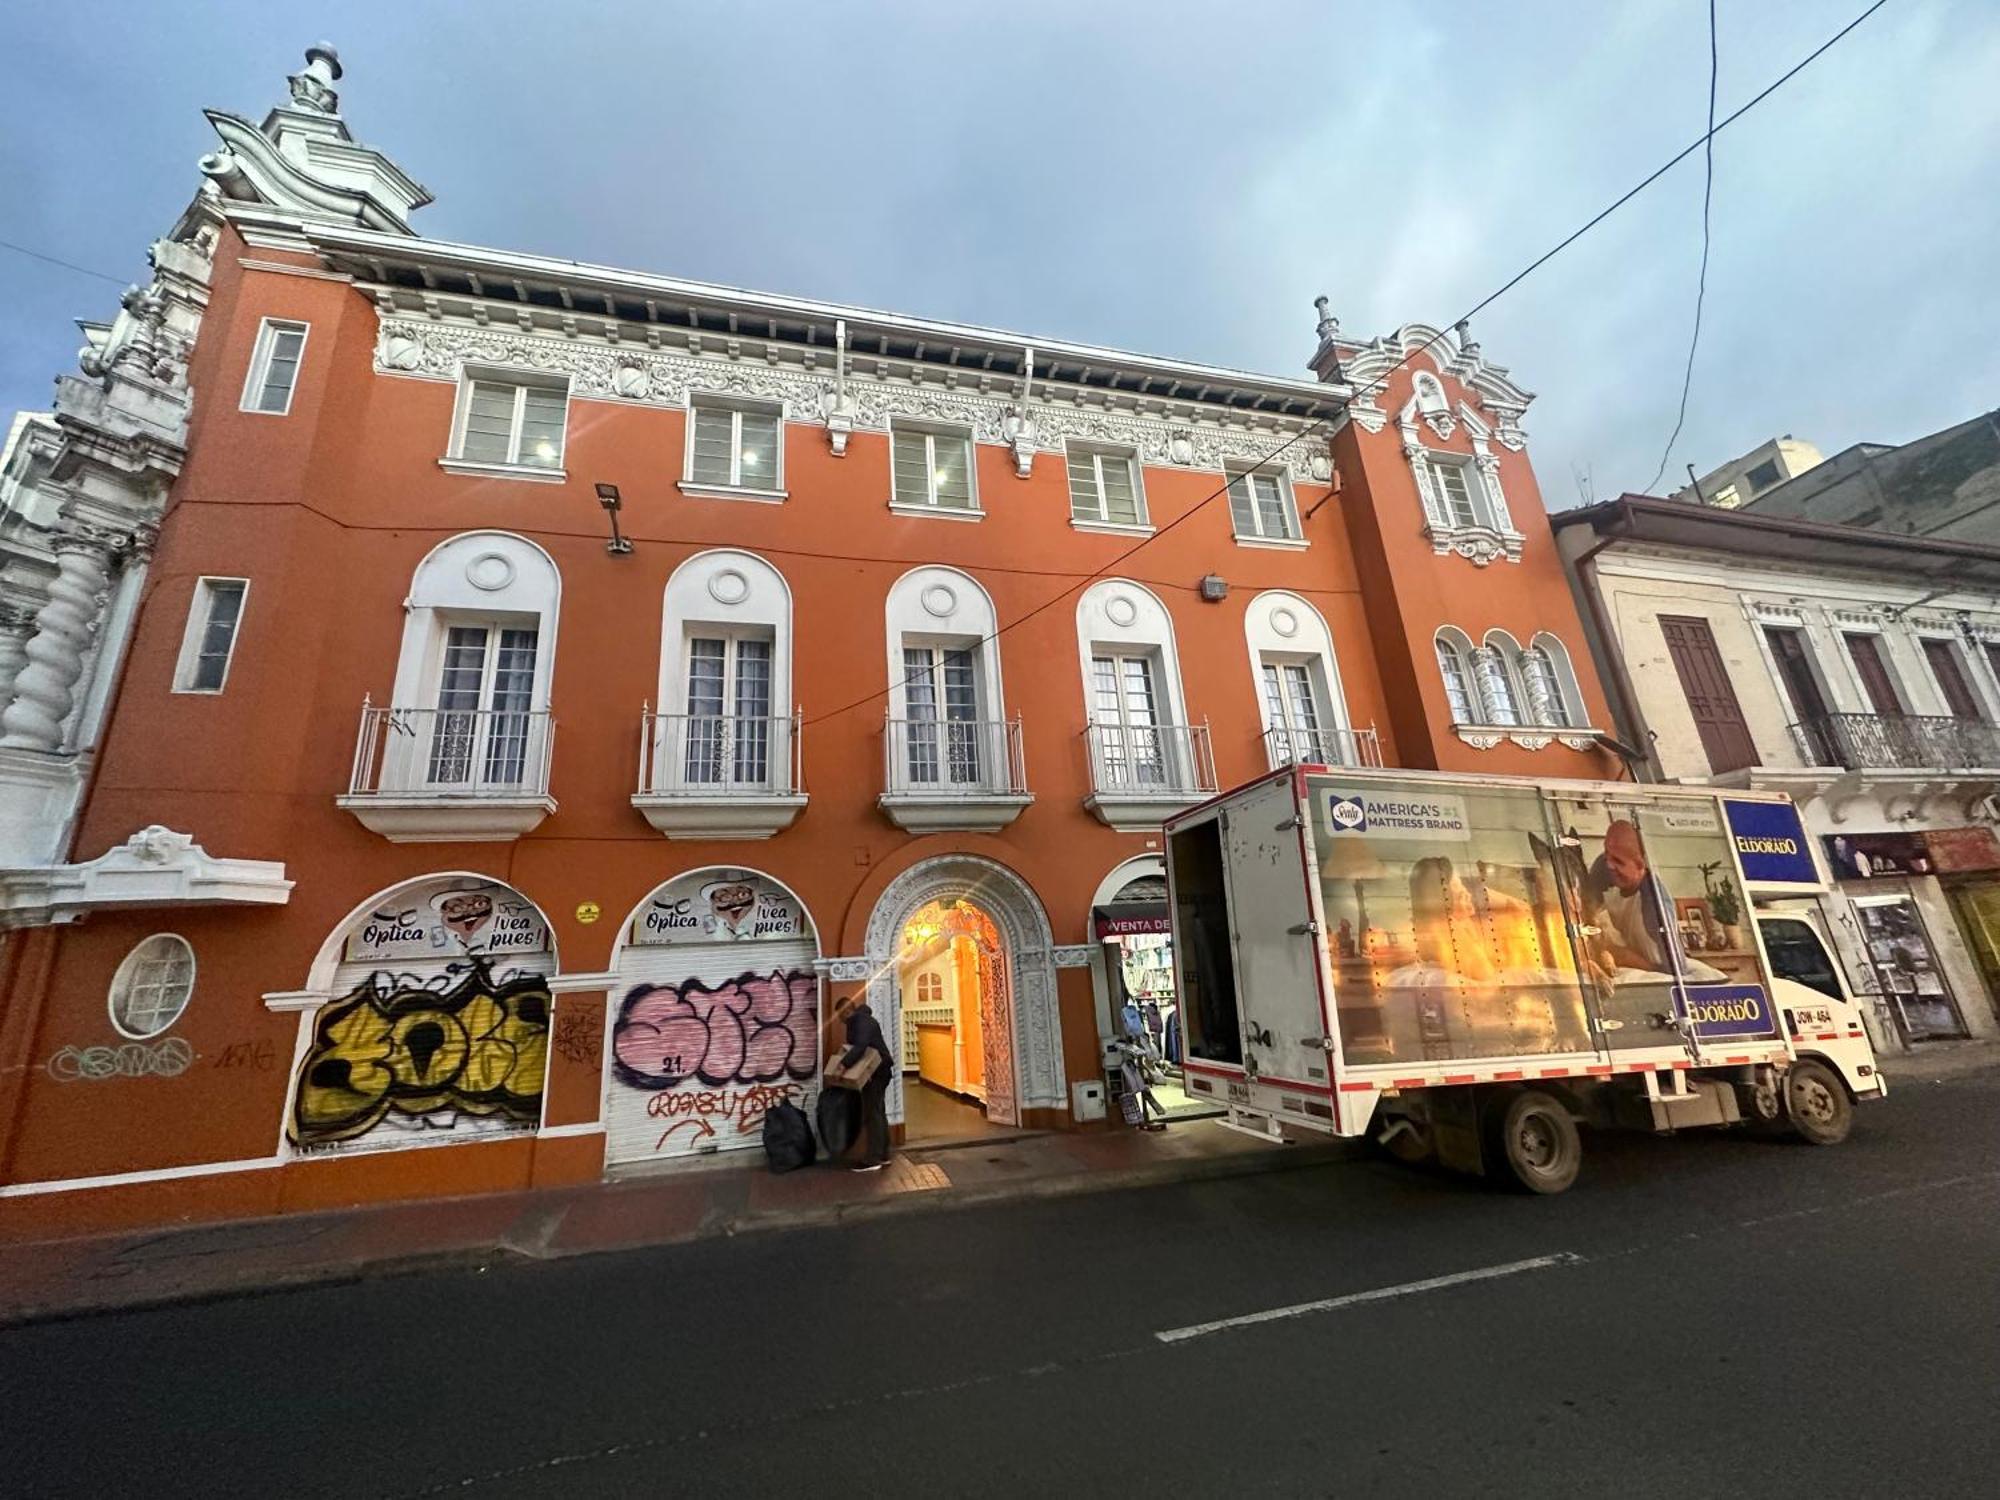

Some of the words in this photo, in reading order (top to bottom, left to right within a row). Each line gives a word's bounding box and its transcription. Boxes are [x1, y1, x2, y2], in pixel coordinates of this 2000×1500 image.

[1367, 803, 1440, 817] AMERICA'S
[1368, 818, 1424, 829] MATTRESS
[1426, 819, 1463, 830] BRAND
[754, 917, 798, 938] pues!
[1112, 921, 1152, 932] VENTA
[1154, 920, 1170, 930] DE
[489, 929, 542, 951] pues!
